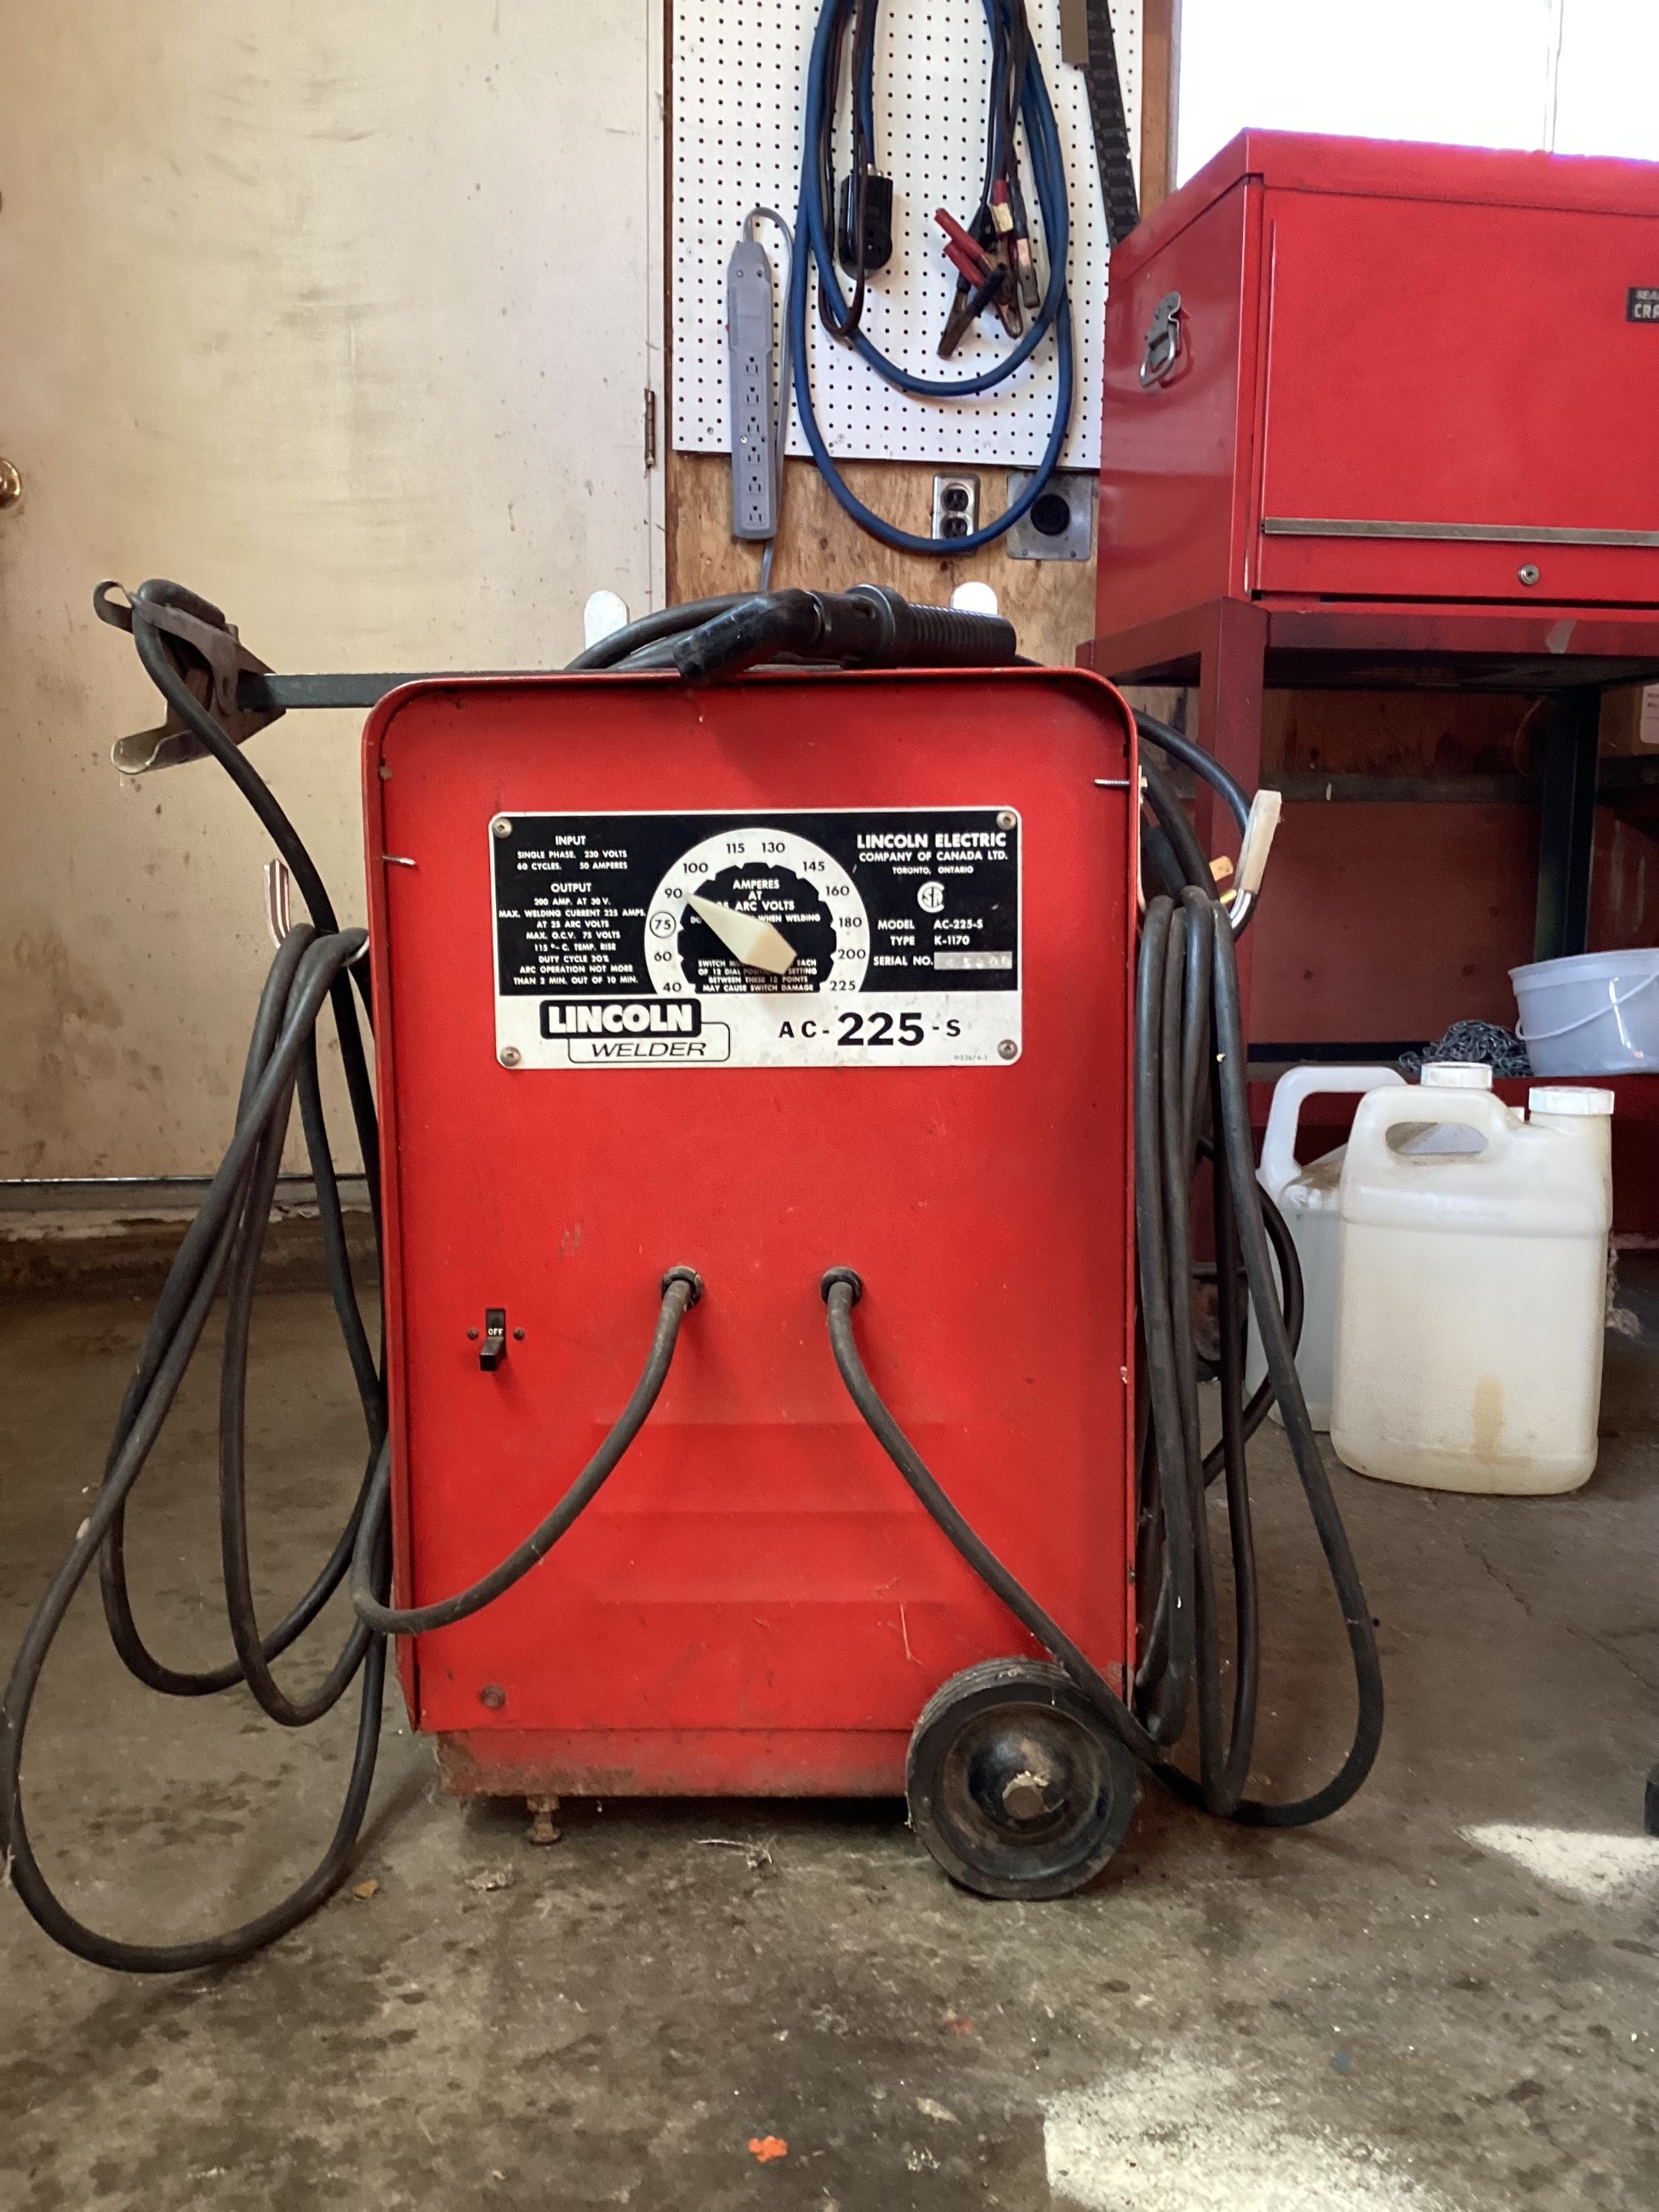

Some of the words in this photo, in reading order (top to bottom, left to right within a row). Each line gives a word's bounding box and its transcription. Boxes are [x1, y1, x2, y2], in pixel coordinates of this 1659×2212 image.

[555, 835, 586, 846] INPUT
[857, 834, 928, 848] LINCOLN
[935, 832, 1006, 848] ELECTRIC
[726, 843, 745, 853] 115
[761, 842, 786, 852] 130
[517, 851, 544, 859] SINGLE
[602, 850, 627, 858] VOLTS
[858, 852, 912, 862] COMPANY
[917, 852, 932, 862] OF
[936, 851, 983, 861] CANADA
[988, 850, 1008, 860] LTD.
[592, 861, 628, 869] AMPERES
[683, 863, 709, 874] 100
[803, 861, 825, 872] 145
[938, 865, 974, 875] ONTARIO
[550, 882, 592, 892] OUTPUT
[733, 879, 780, 890] AMPERES
[664, 888, 683, 898] 90
[748, 891, 762, 901] AT
[826, 886, 850, 897] 160
[534, 898, 549, 906] 200
[552, 898, 573, 906] AMP.
[735, 901, 757, 911] ARC
[761, 900, 795, 911] VOLTS
[524, 909, 562, 918] WELDING
[622, 909, 647, 917] AMPS.
[758, 915, 782, 923] WHEN
[785, 914, 821, 923] WELDING
[584, 920, 609, 928] VOLTS
[654, 920, 671, 930] 75
[839, 917, 863, 928] 180
[877, 920, 915, 930] MODEL
[933, 919, 983, 929] AC-225-S
[526, 932, 548, 940] MAX.
[551, 932, 577, 940] O.C.V.
[596, 931, 621, 939] VOLTS
[890, 936, 915, 946] TYPE
[934, 936, 970, 946] K-1170
[534, 944, 548, 952] 115
[600, 943, 616, 951] RISE
[563, 955, 588, 963] CYCLE
[591, 955, 609, 963] 20%
[653, 951, 672, 961] 60
[837, 949, 866, 960] 200
[698, 959, 726, 967] SWITCH
[873, 955, 908, 966] SERIAL
[913, 955, 933, 966] NO.
[519, 966, 536, 974] ARC
[549, 977, 567, 985] MIN.
[830, 980, 857, 991] 225
[663, 983, 681, 993] 40
[549, 1004, 693, 1034] LINCOLN
[591, 1042, 707, 1057] WELDER
